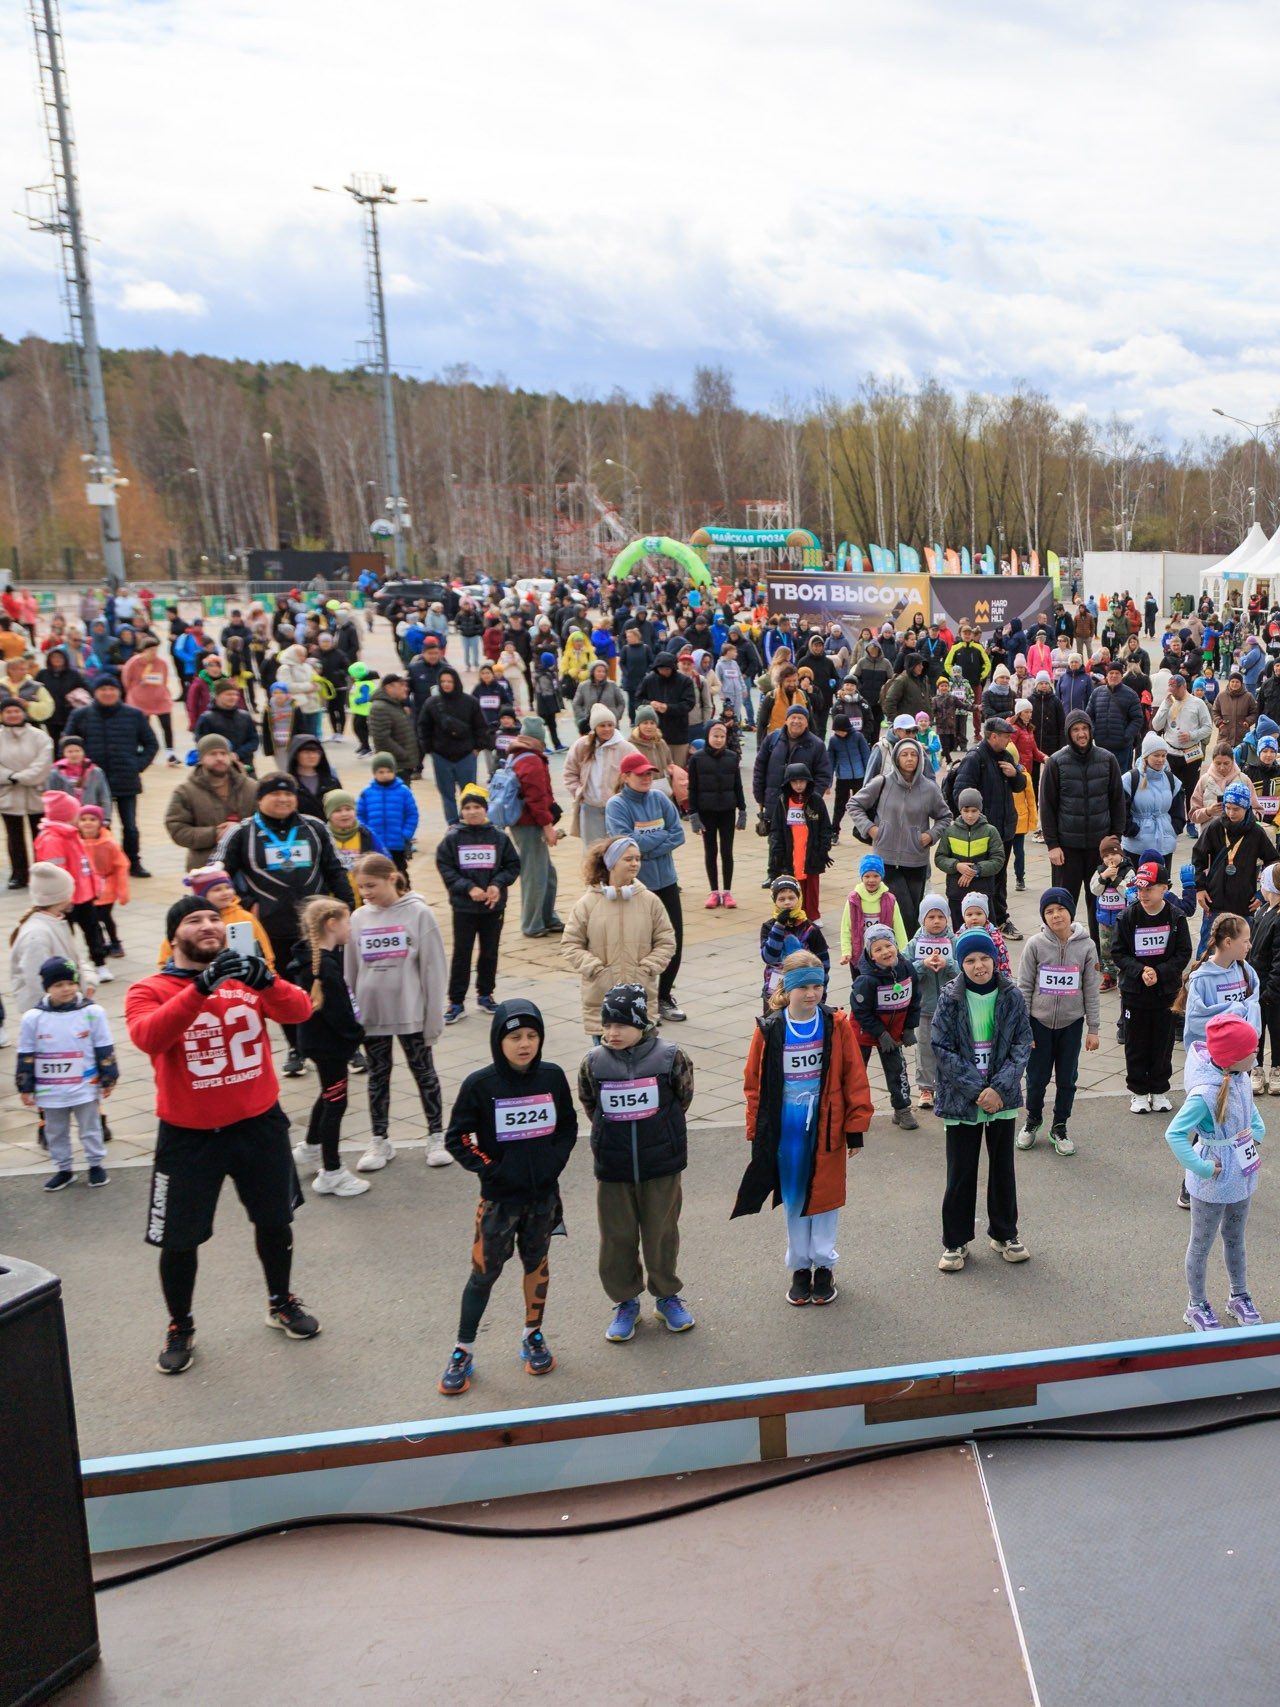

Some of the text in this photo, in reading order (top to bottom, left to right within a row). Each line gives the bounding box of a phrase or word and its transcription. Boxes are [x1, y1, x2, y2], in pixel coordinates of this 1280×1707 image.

[711, 532, 785, 543] МАЙСКАЯ ГРОЗА
[770, 583, 923, 604] ТВОЯ ВЫСОТА
[276, 850, 301, 860] 84
[464, 852, 492, 861] 5203
[366, 936, 400, 949] 5098
[1142, 936, 1165, 946] 5112
[1046, 976, 1074, 986] 5142
[884, 988, 910, 1002] 5027
[184, 1026, 223, 1040] VARSITY
[186, 1047, 227, 1061] COLLEGE
[791, 1052, 823, 1068] 5107
[42, 1062, 74, 1074] 5117
[192, 1077, 223, 1090] SUPER
[610, 1092, 649, 1108] 5154
[505, 1108, 549, 1127] 5224
